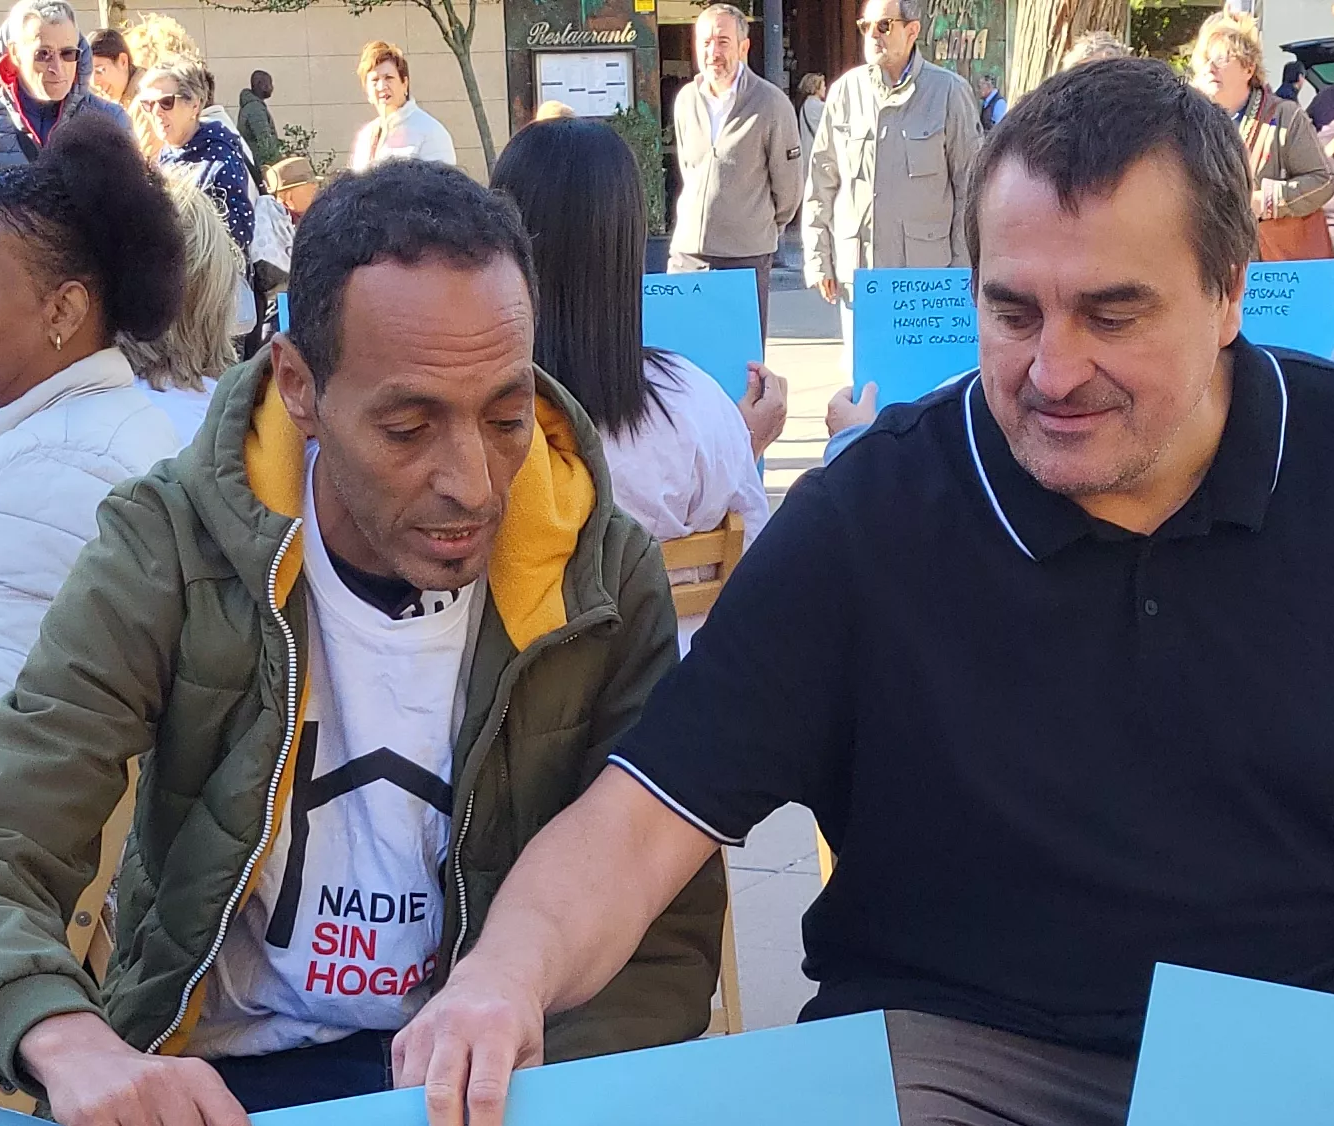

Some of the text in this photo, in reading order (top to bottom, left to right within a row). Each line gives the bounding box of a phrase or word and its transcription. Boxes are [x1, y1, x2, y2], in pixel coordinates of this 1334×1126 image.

[527, 21, 638, 45] Restaurante
[692, 283, 702, 293] A
[891, 279, 953, 293] PERSONAS
[1251, 271, 1300, 283] CIERRA
[893, 299, 916, 311] LAS
[921, 297, 966, 310] PUERTAS
[893, 316, 945, 329] MAYORES
[951, 315, 971, 328] SIN
[895, 334, 924, 345] UNAS
[317, 884, 428, 924] NADIE
[311, 921, 377, 961] SIN
